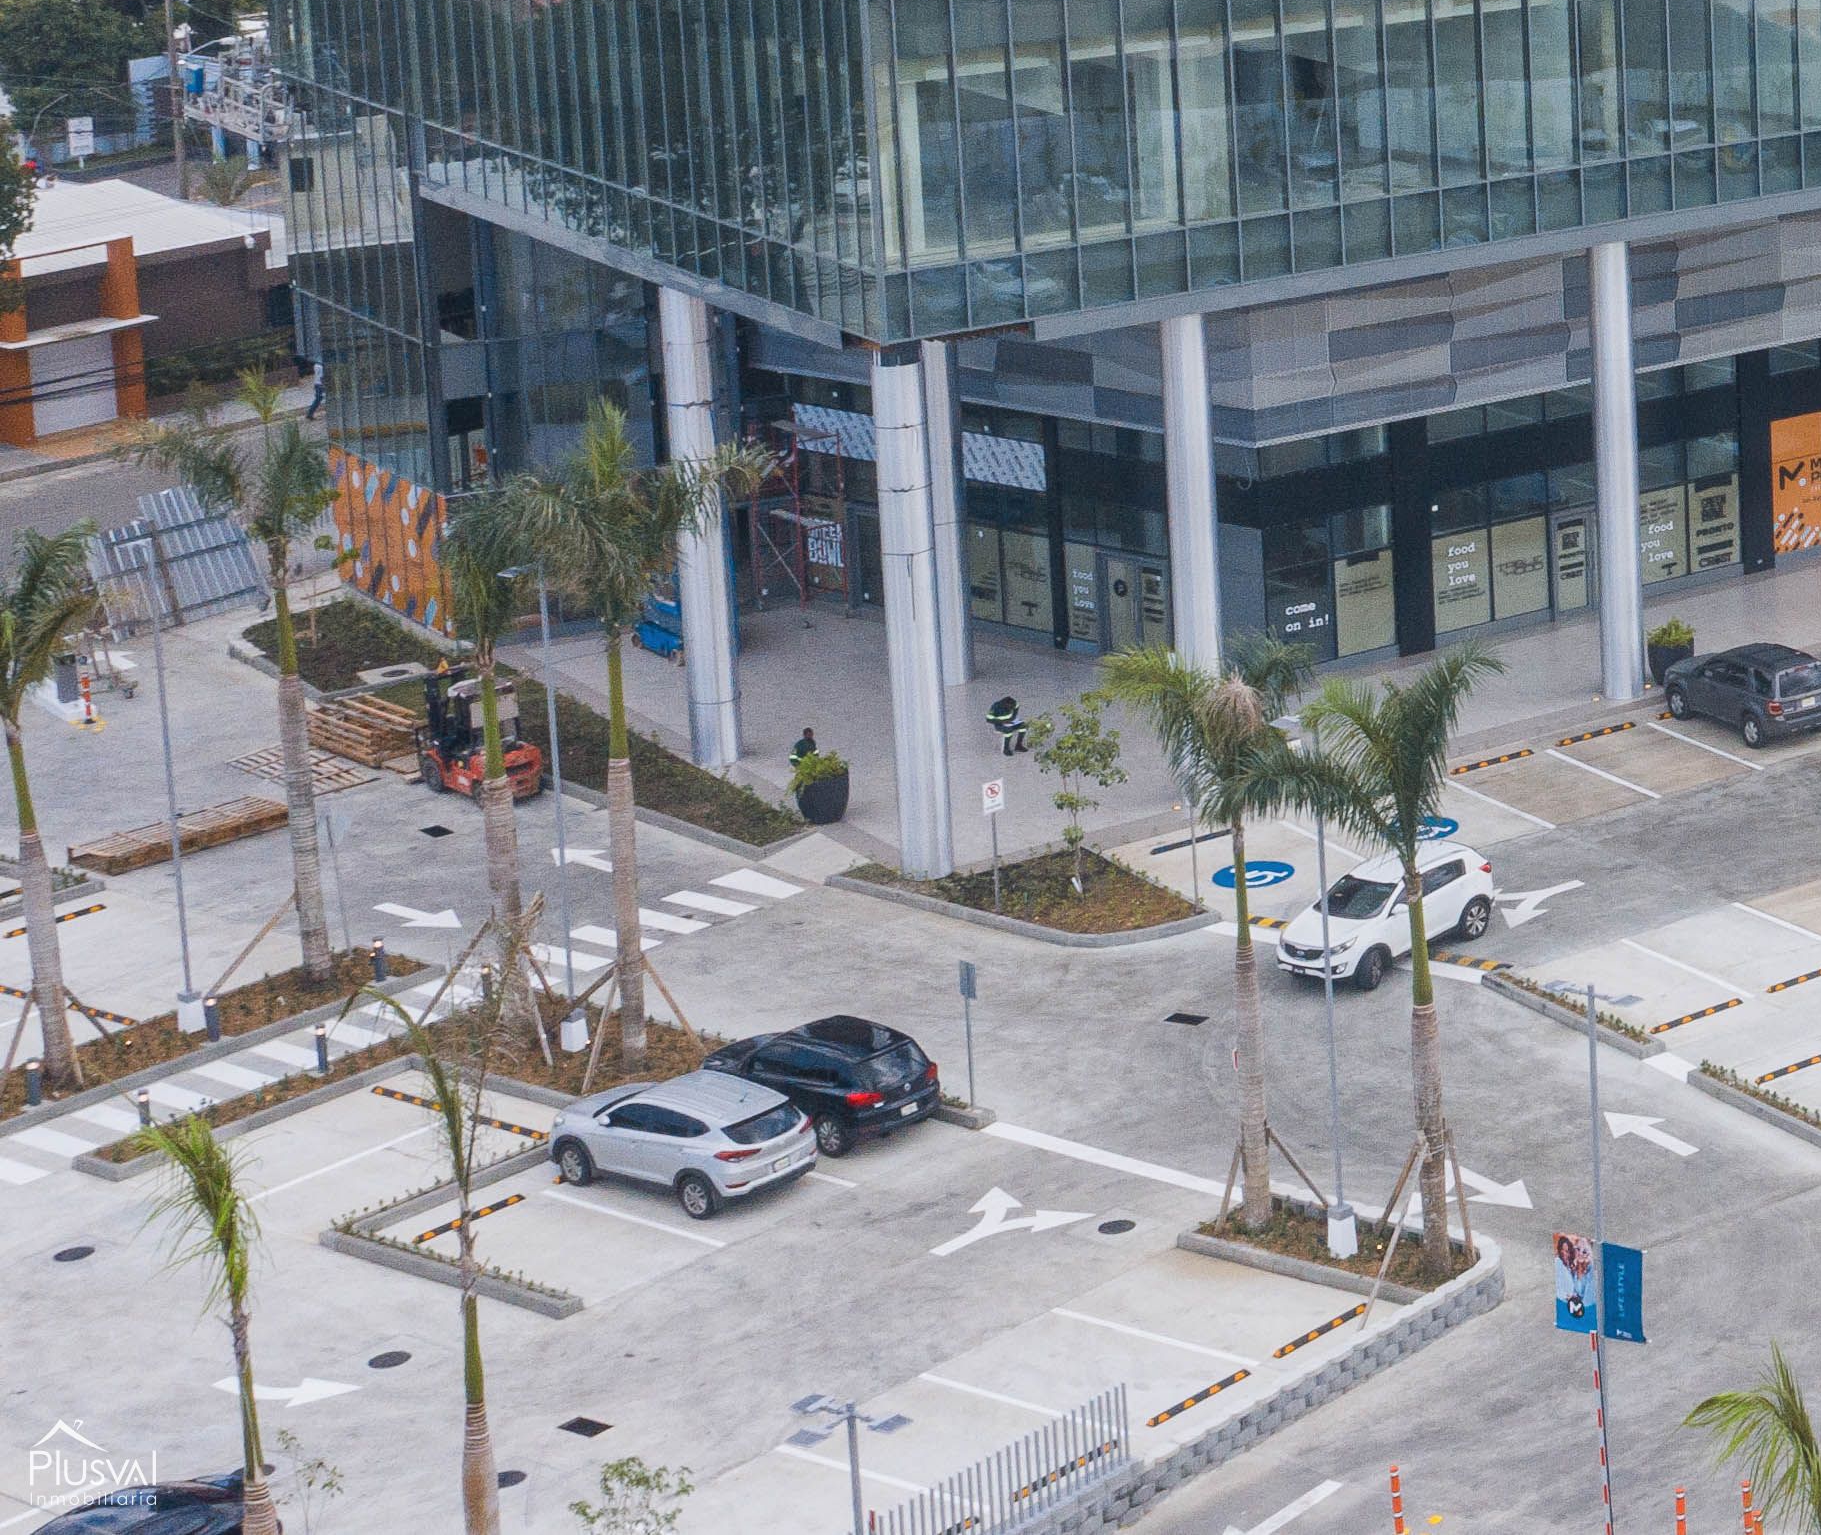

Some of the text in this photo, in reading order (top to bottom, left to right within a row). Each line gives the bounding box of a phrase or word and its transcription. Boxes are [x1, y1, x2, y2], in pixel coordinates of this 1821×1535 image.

[1648, 520, 1674, 535] food
[1448, 543, 1475, 557] food
[1641, 539, 1660, 553] you
[1648, 550, 1674, 562] love
[1448, 560, 1468, 574] you
[1449, 572, 1476, 586] love
[1285, 602, 1316, 616] come
[1285, 613, 1329, 633] on in!
